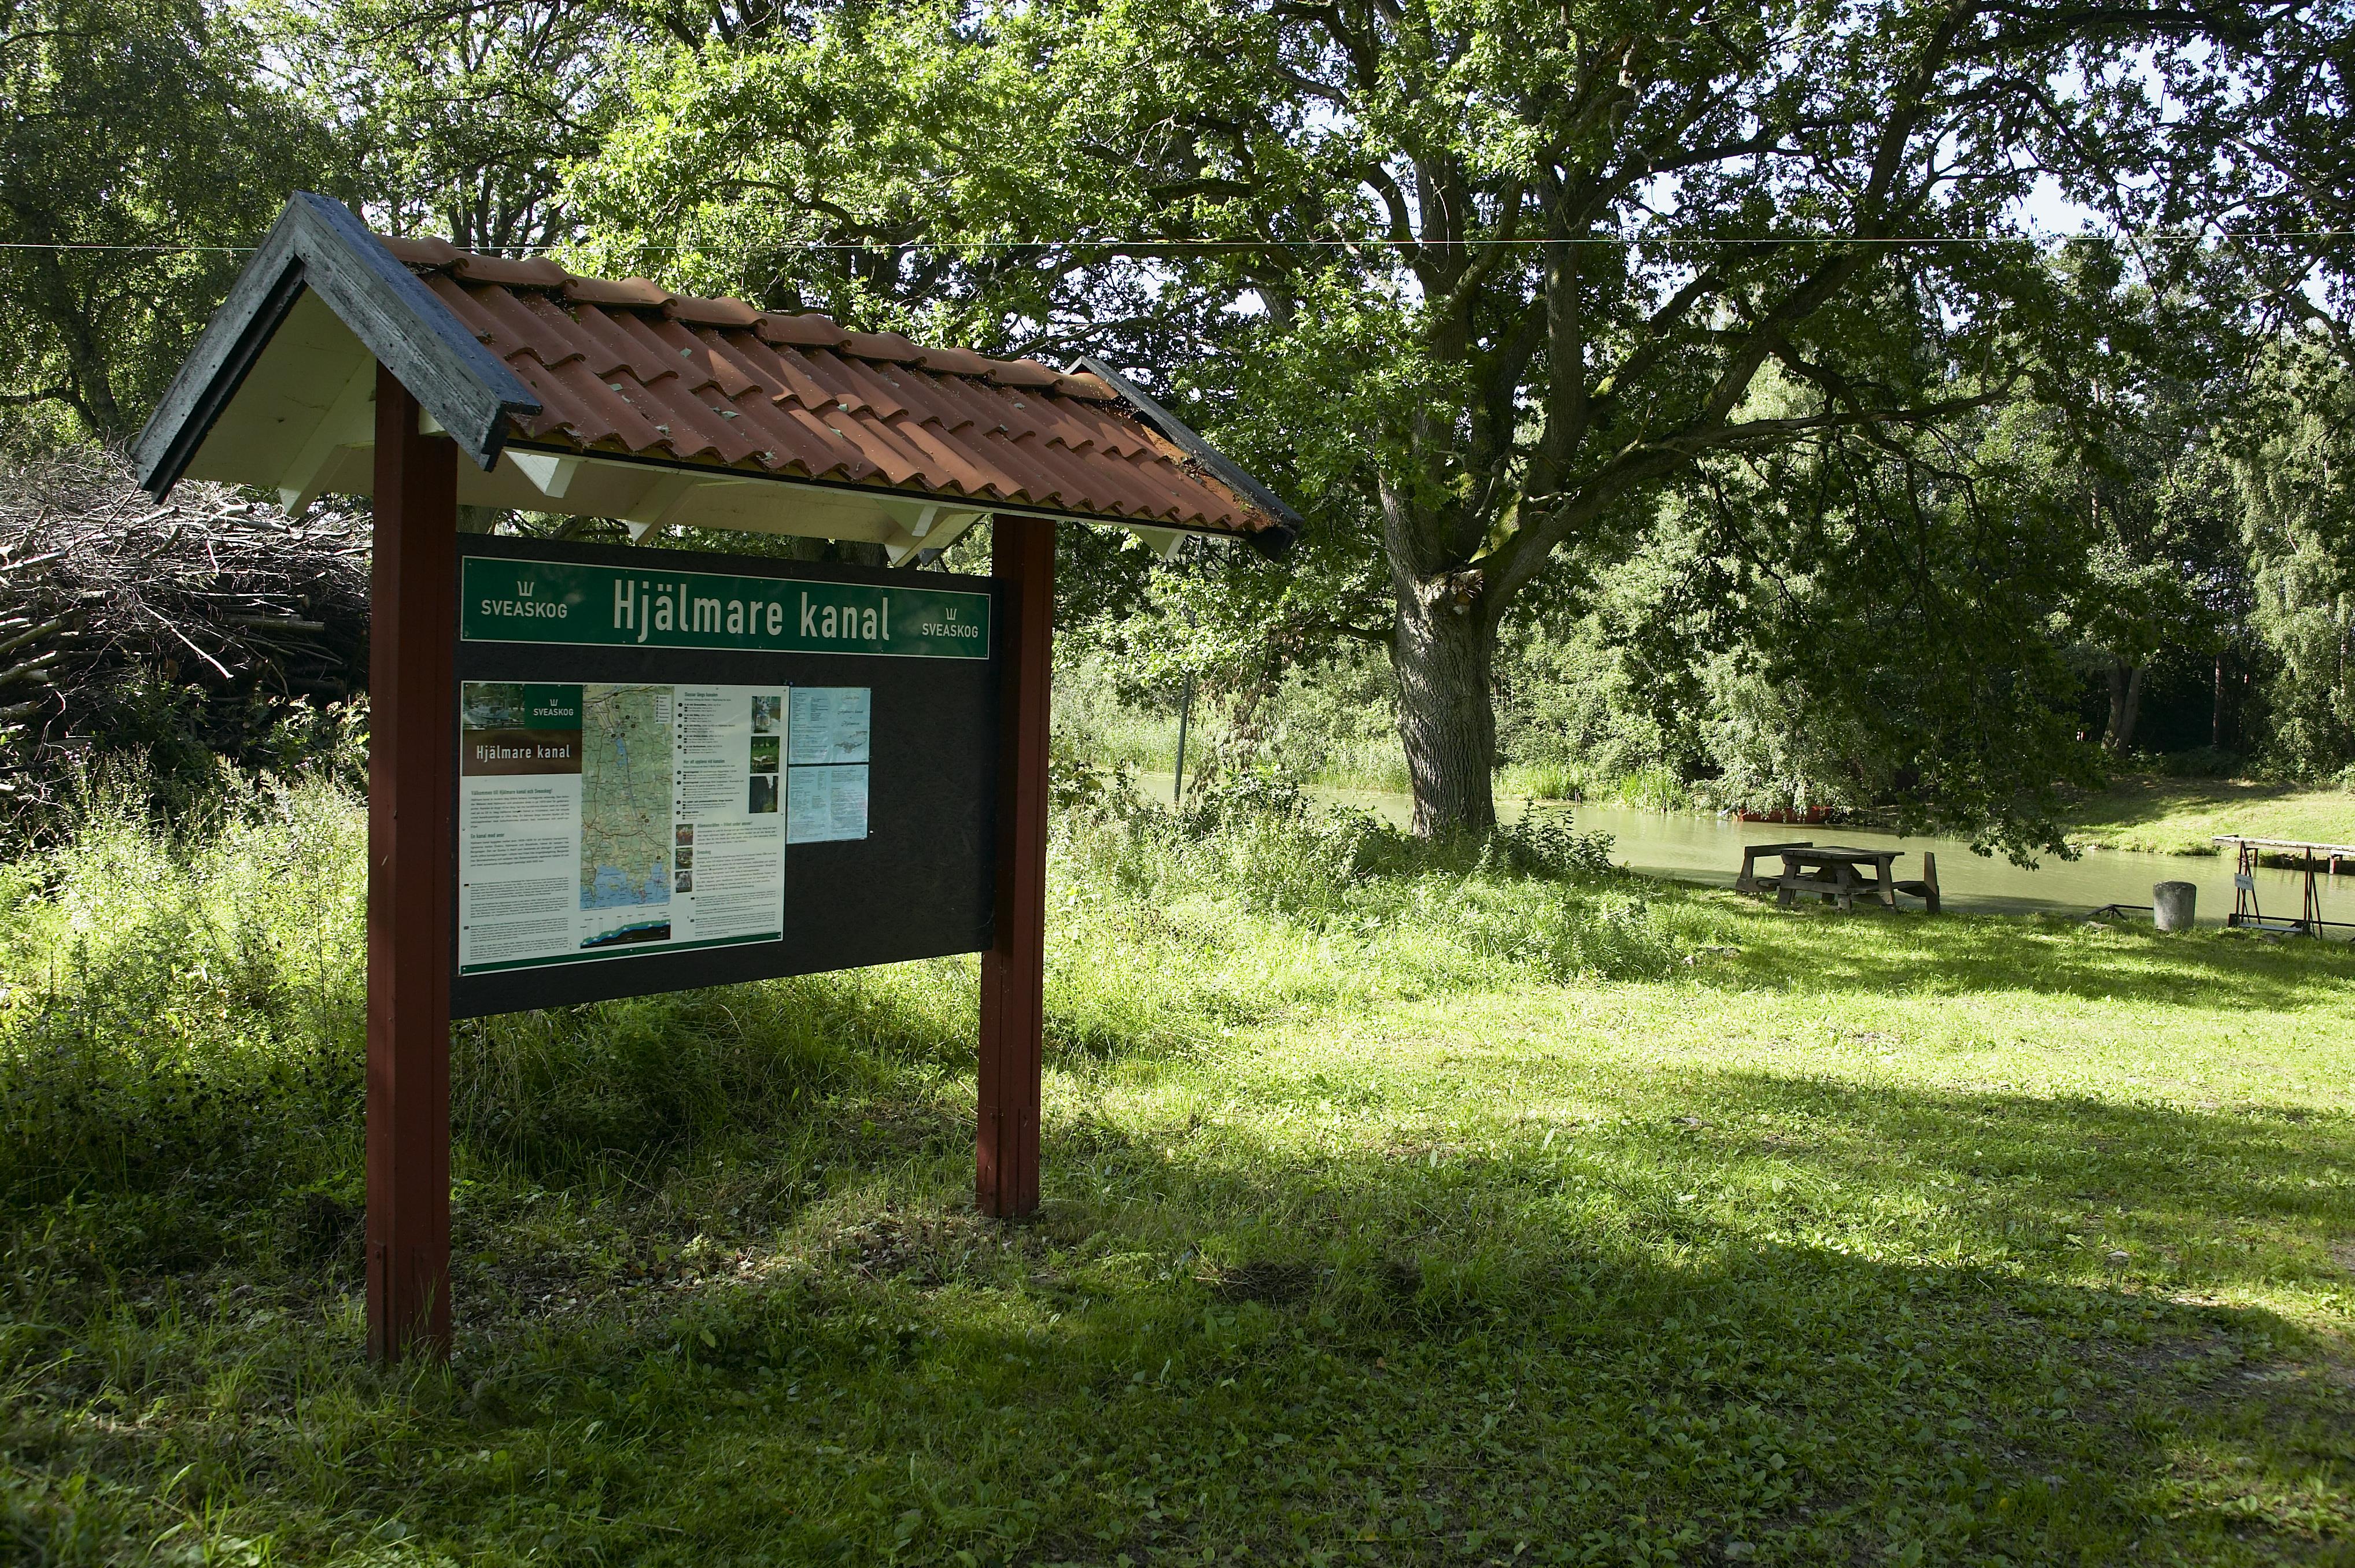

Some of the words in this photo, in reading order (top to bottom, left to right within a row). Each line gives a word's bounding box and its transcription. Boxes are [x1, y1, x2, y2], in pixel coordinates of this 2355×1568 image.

[481, 600, 567, 619] SVEASKOG
[614, 579, 782, 643] Hjälmare
[800, 591, 889, 641] kanal
[922, 623, 979, 638] SVEASKOG
[476, 745, 531, 763] Hjälmare
[537, 744, 570, 759] kanal
